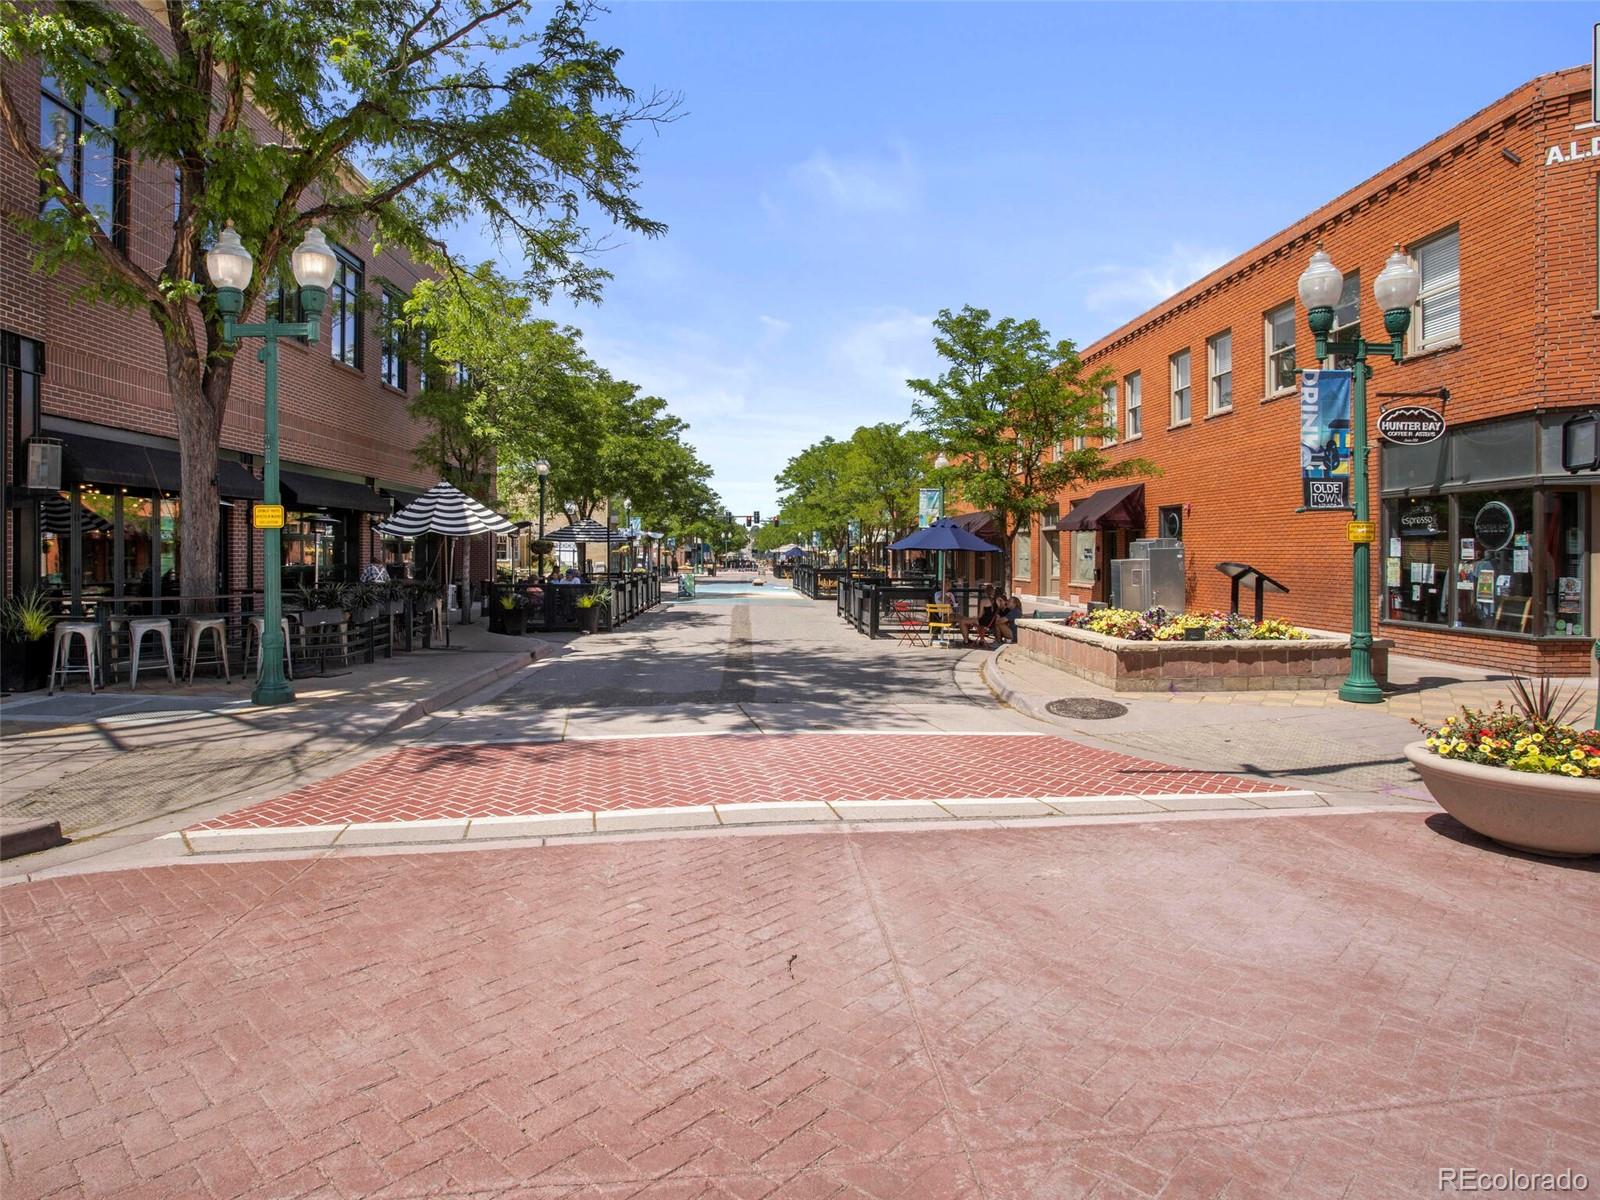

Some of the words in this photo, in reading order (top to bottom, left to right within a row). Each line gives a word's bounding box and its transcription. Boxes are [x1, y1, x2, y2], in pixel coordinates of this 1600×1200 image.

[1381, 421, 1421, 431] HUNTER
[1422, 421, 1442, 431] BAY
[1313, 483, 1339, 494] OLDE
[1312, 493, 1341, 503] TOWN
